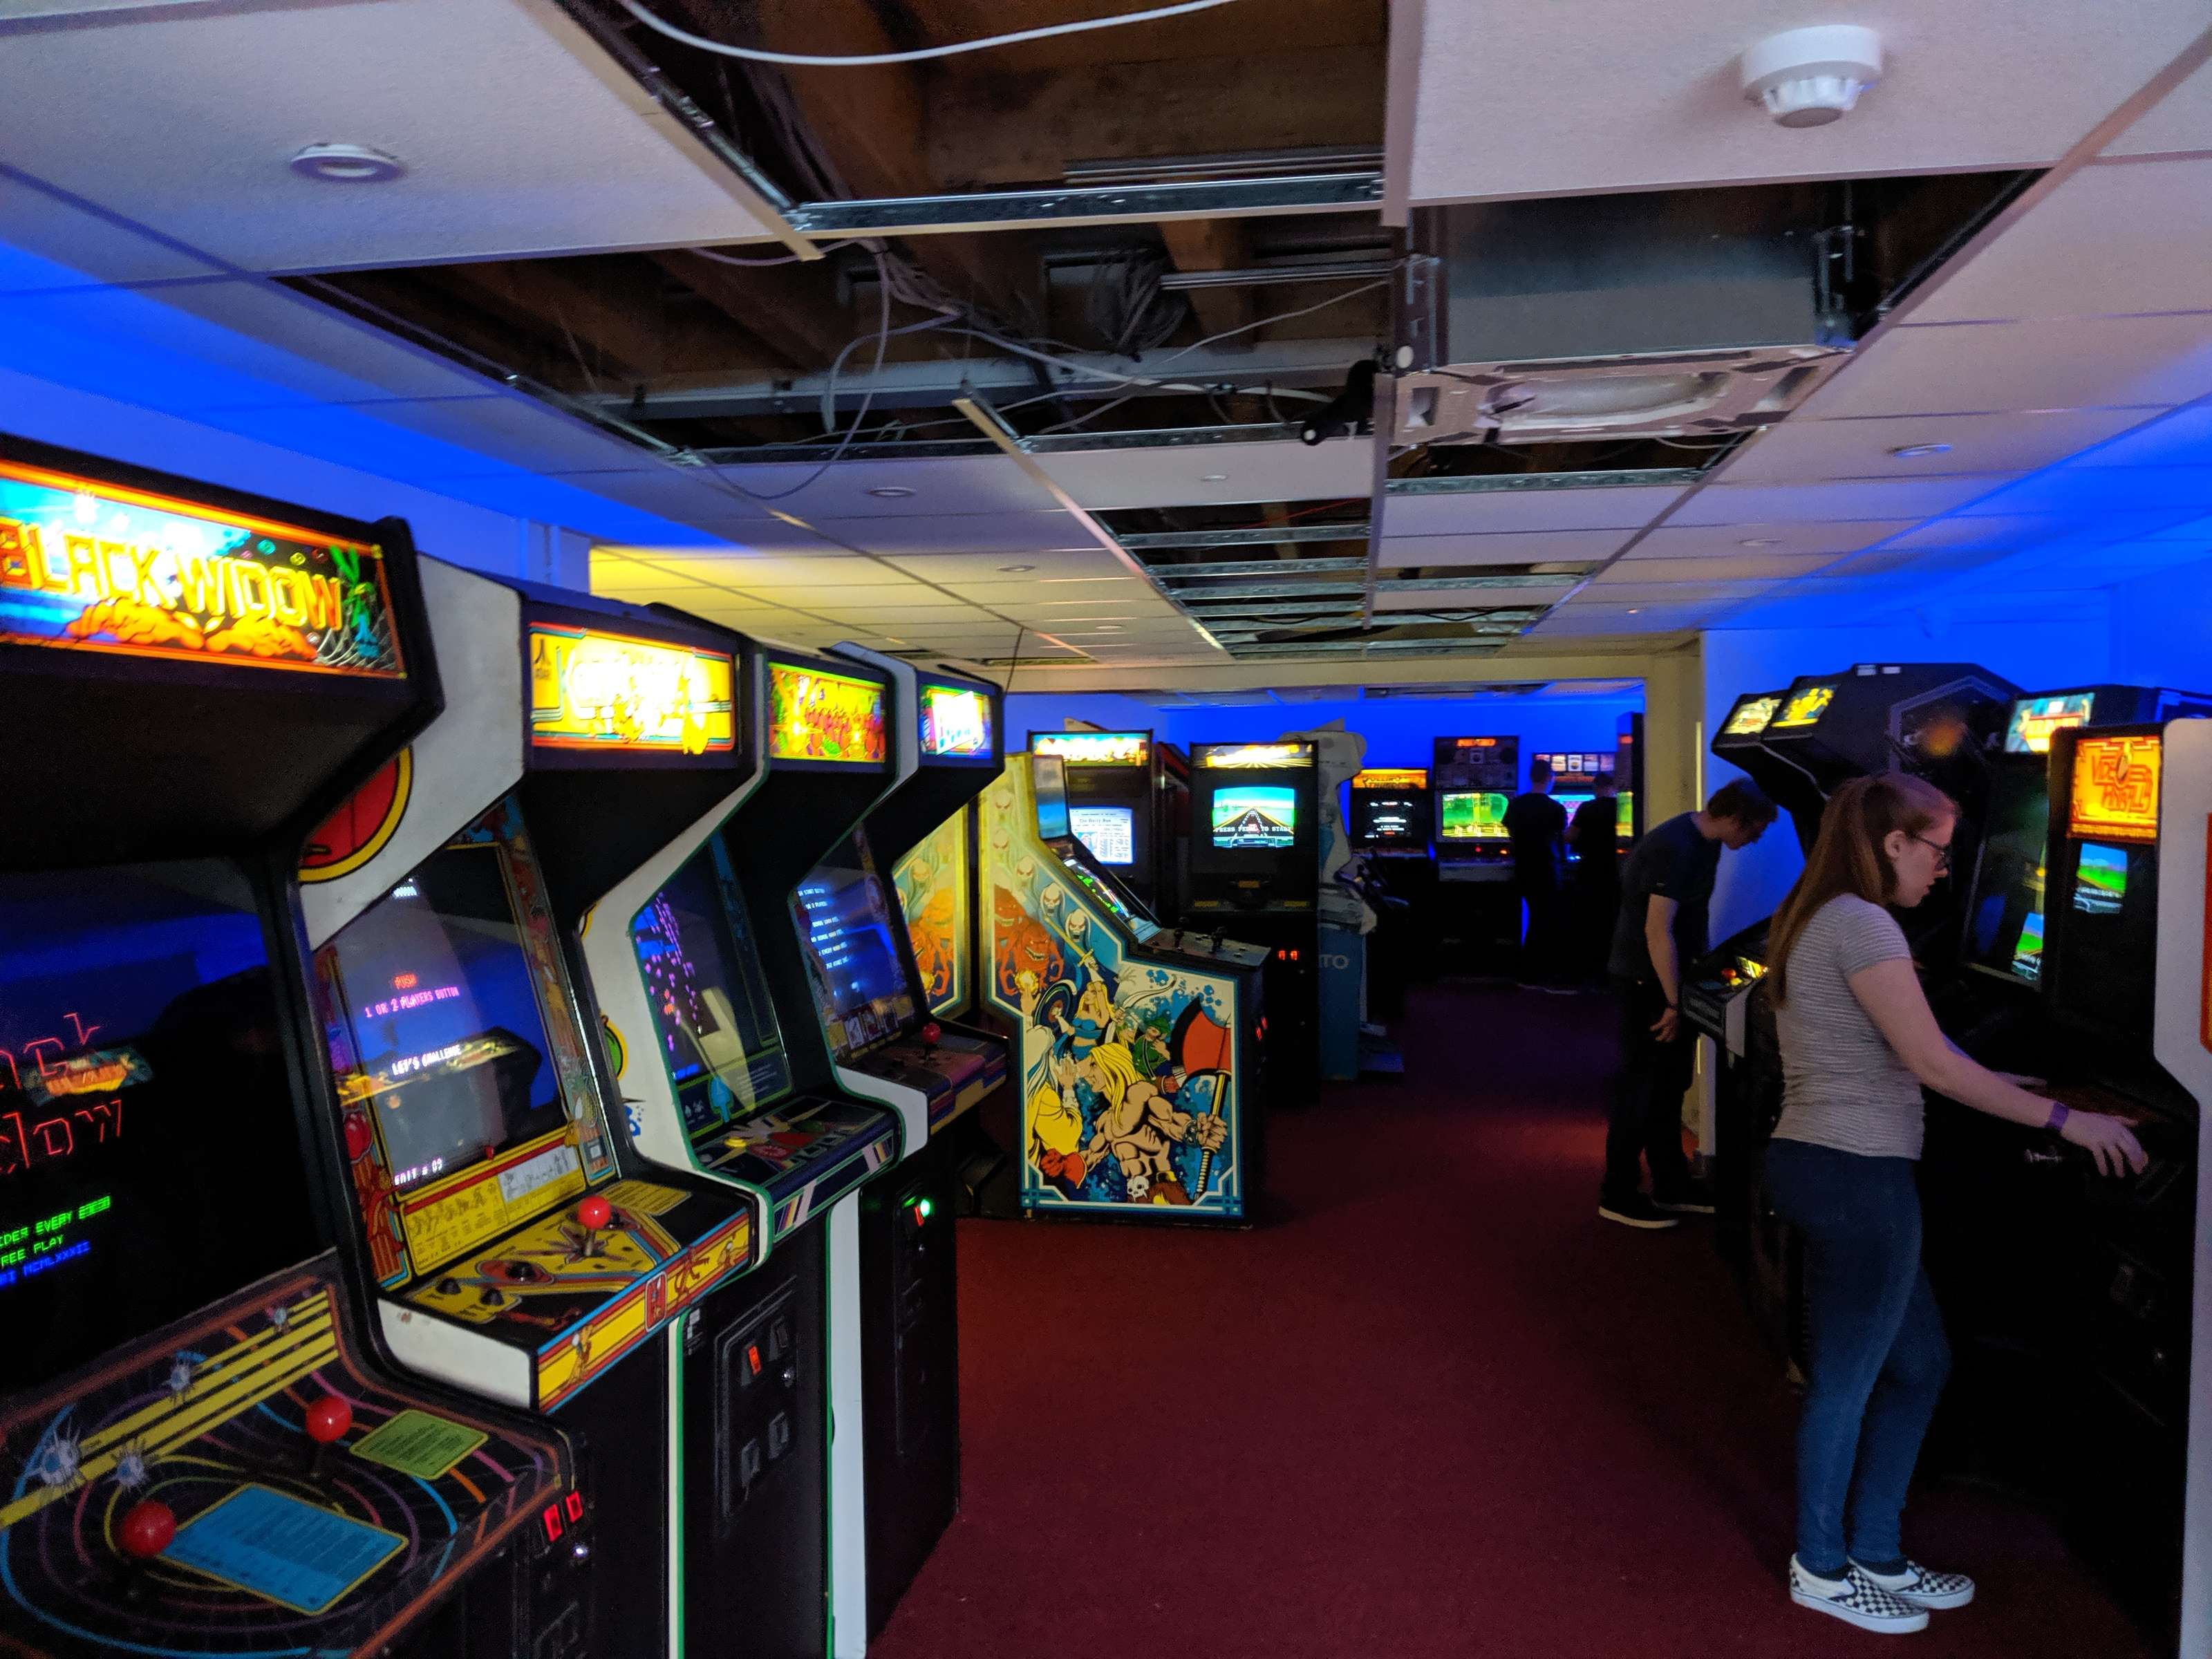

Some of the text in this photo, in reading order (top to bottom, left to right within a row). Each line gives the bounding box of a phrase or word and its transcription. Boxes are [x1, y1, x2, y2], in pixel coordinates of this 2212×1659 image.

[0, 517, 343, 630] BLACK WIDOW
[364, 1006, 373, 1018] 1
[375, 1002, 388, 1015] OR
[391, 999, 400, 1012] 2
[400, 991, 433, 1009] PLAYERS
[35, 1211, 73, 1235] EVERY
[33, 1235, 64, 1253] PLAY
